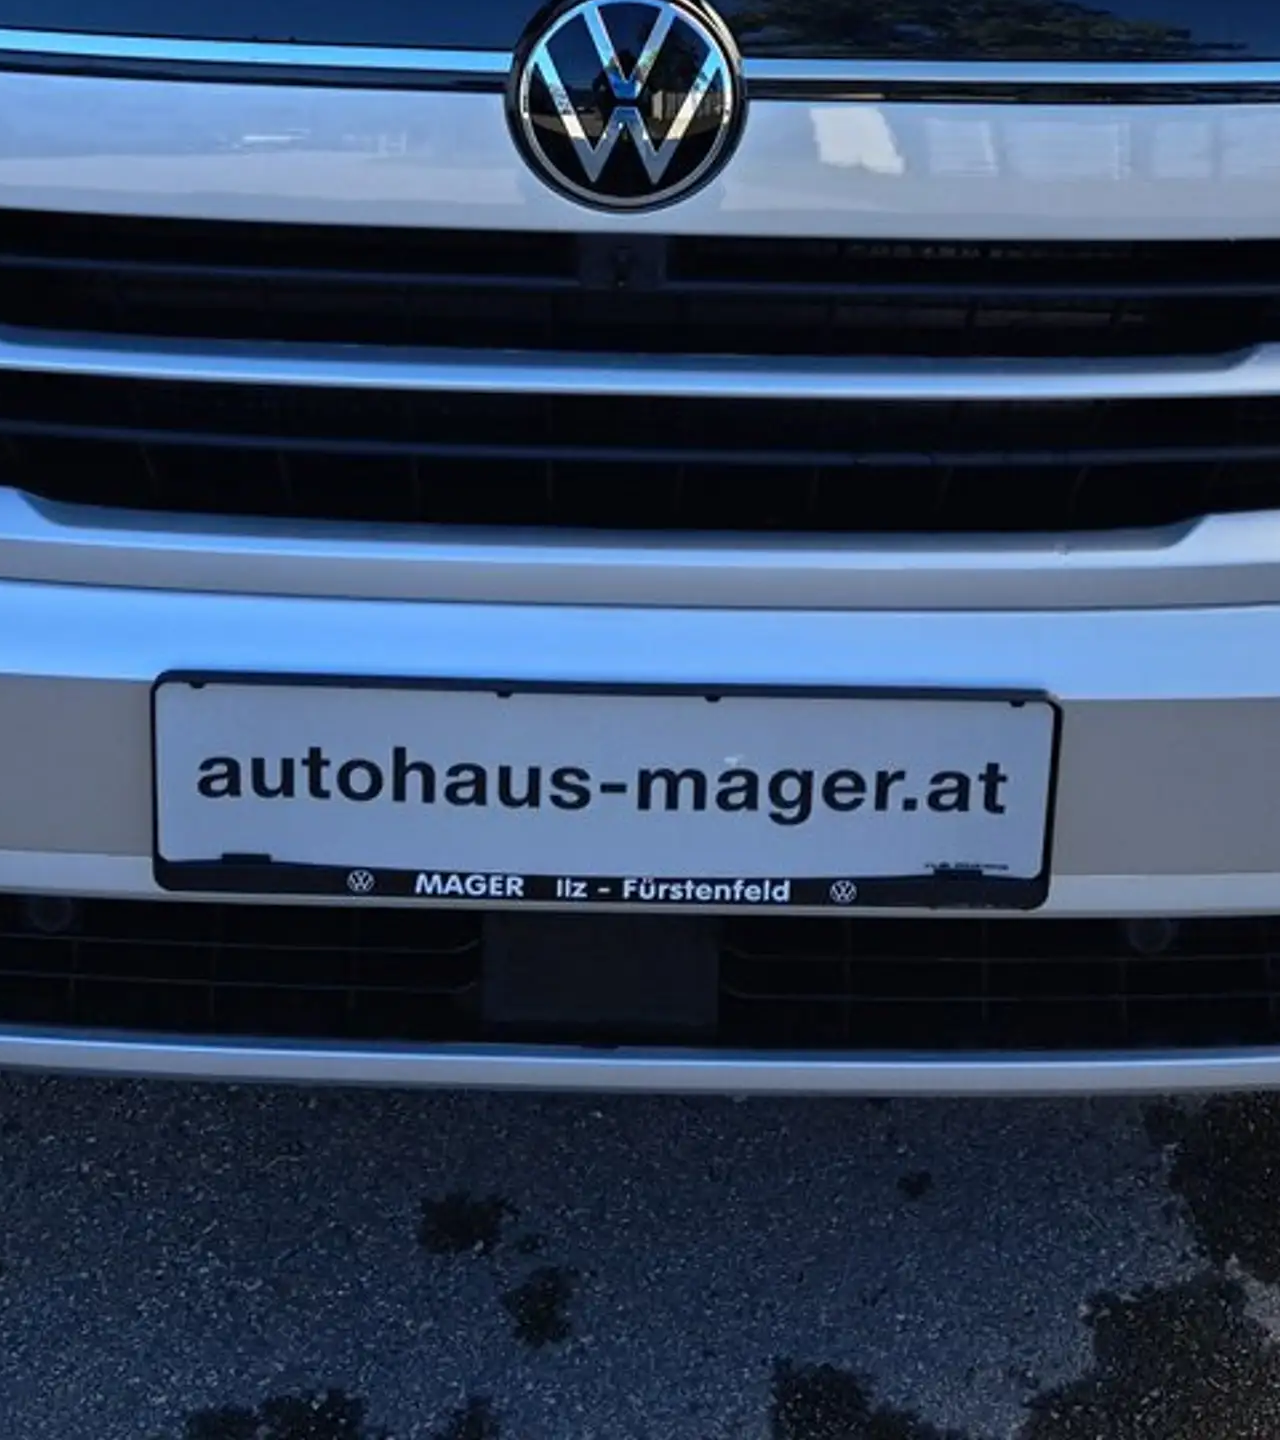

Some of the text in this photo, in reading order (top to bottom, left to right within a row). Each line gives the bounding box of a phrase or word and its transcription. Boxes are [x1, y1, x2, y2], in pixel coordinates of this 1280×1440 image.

[196, 745, 1008, 826] autohaus-mager.at
[414, 872, 525, 898] MAGER
[622, 878, 791, 903] Fürstenfeld
